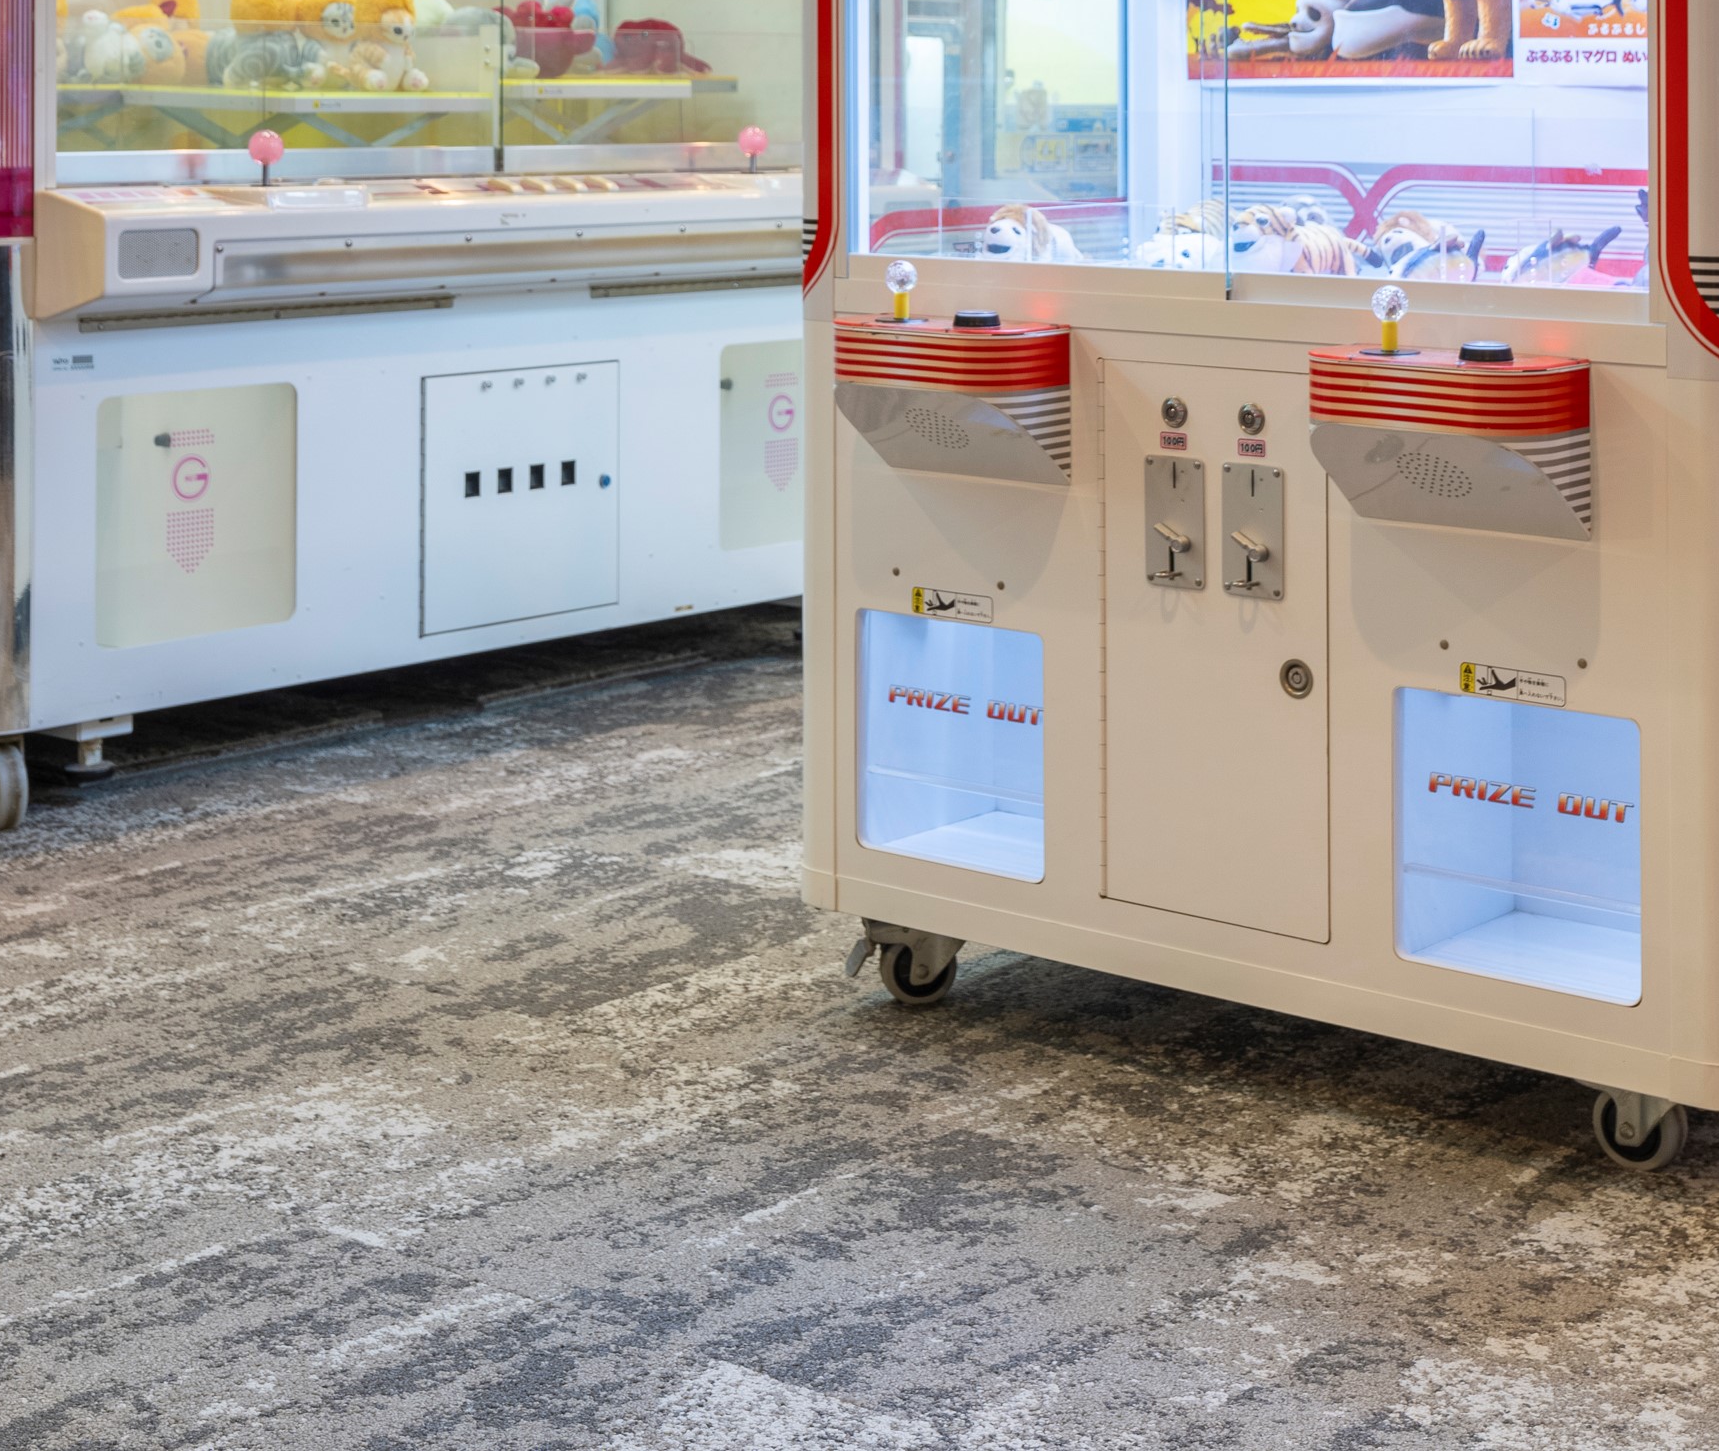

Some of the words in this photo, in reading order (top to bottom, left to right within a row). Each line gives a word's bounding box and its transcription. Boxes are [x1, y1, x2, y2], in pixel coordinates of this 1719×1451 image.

[1162, 436, 1185, 448] 100円
[1240, 443, 1263, 454] 100円
[888, 684, 971, 715] PRIZE
[986, 699, 1044, 725] OUT
[1428, 771, 1536, 809] PRIZE
[1557, 792, 1635, 823] OUT
